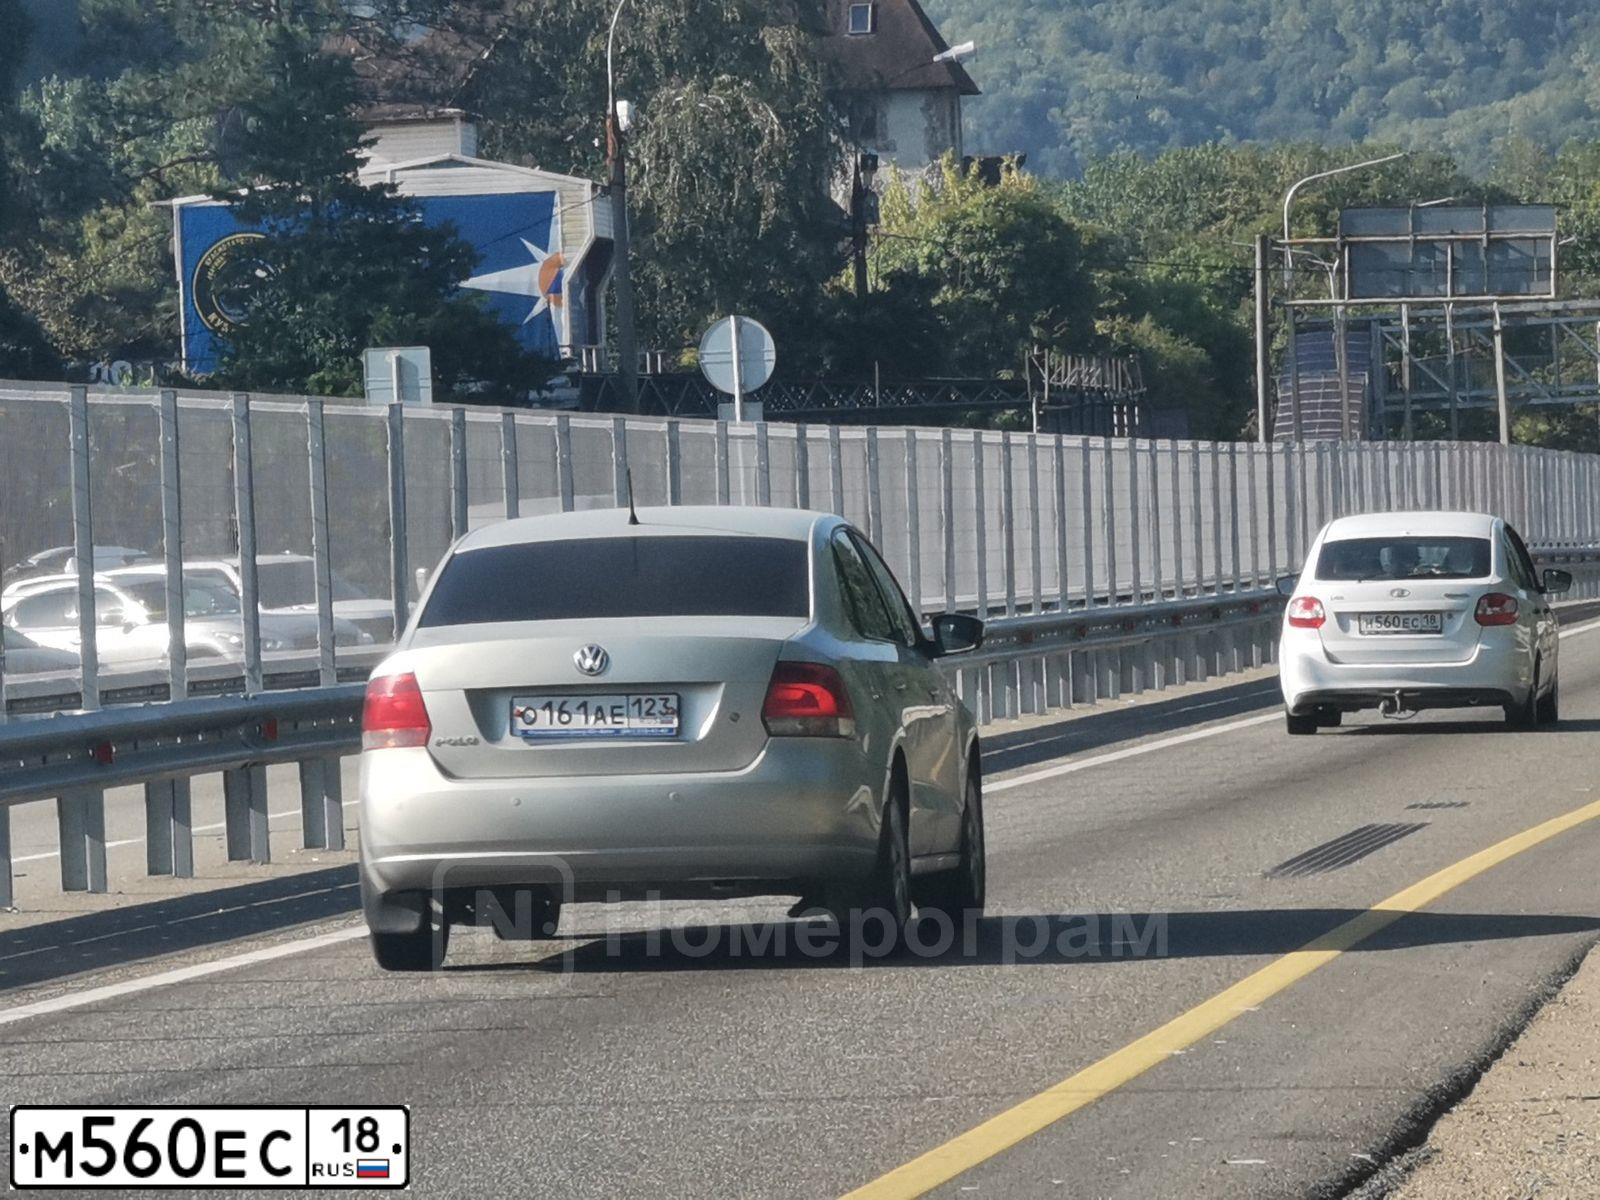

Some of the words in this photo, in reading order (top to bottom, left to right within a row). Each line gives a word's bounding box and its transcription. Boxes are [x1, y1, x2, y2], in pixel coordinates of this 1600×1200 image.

[1422, 614, 1436, 625] 18
[522, 701, 624, 726] О161АЕ
[630, 698, 676, 717] 123
